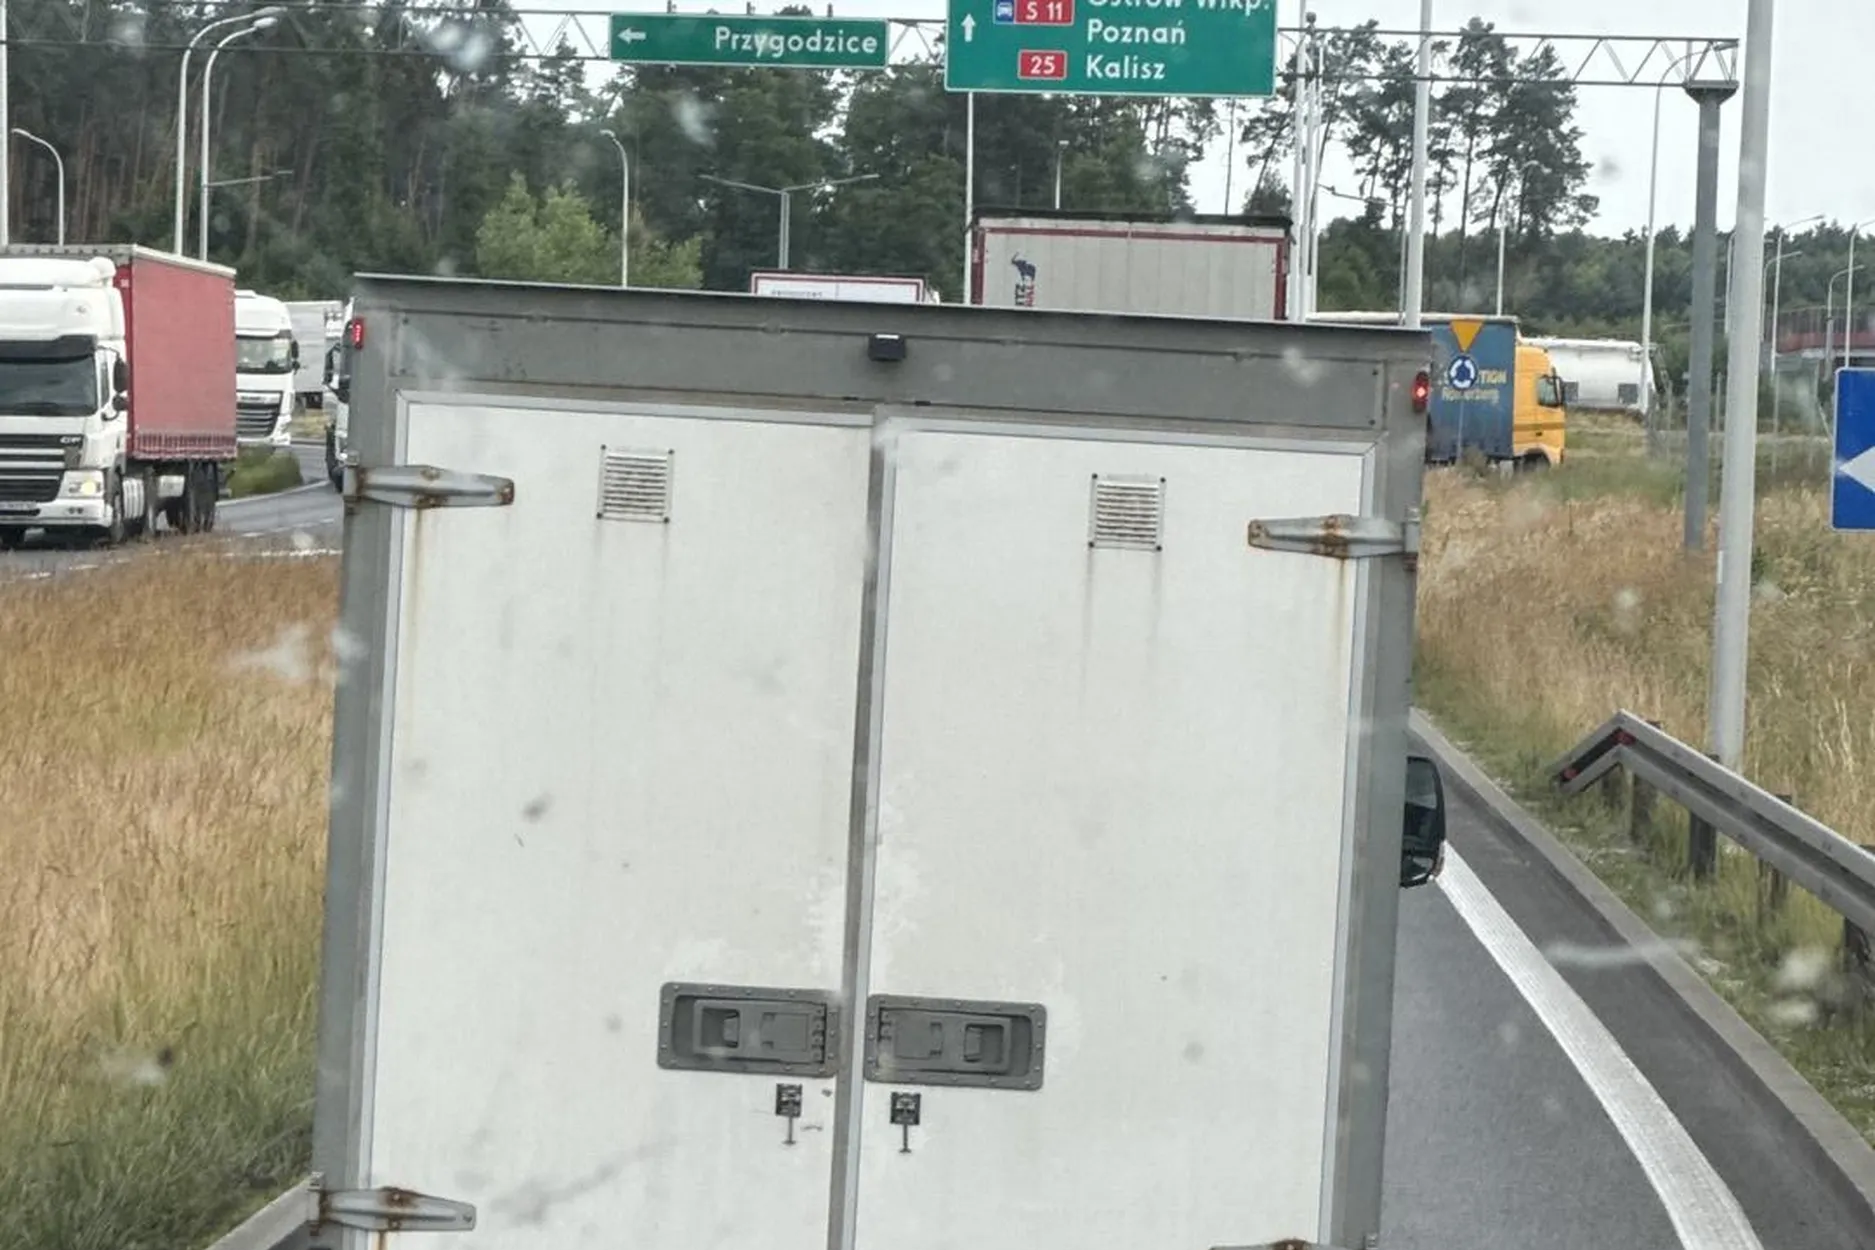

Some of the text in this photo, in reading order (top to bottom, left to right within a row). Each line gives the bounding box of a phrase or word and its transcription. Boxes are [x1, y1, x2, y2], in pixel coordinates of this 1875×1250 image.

[1026, 1, 1062, 20] S 11
[715, 26, 878, 58] Przygodzice
[1087, 18, 1186, 44] Poznań
[1030, 57, 1055, 75] 25
[1086, 54, 1166, 79] Kalisz
